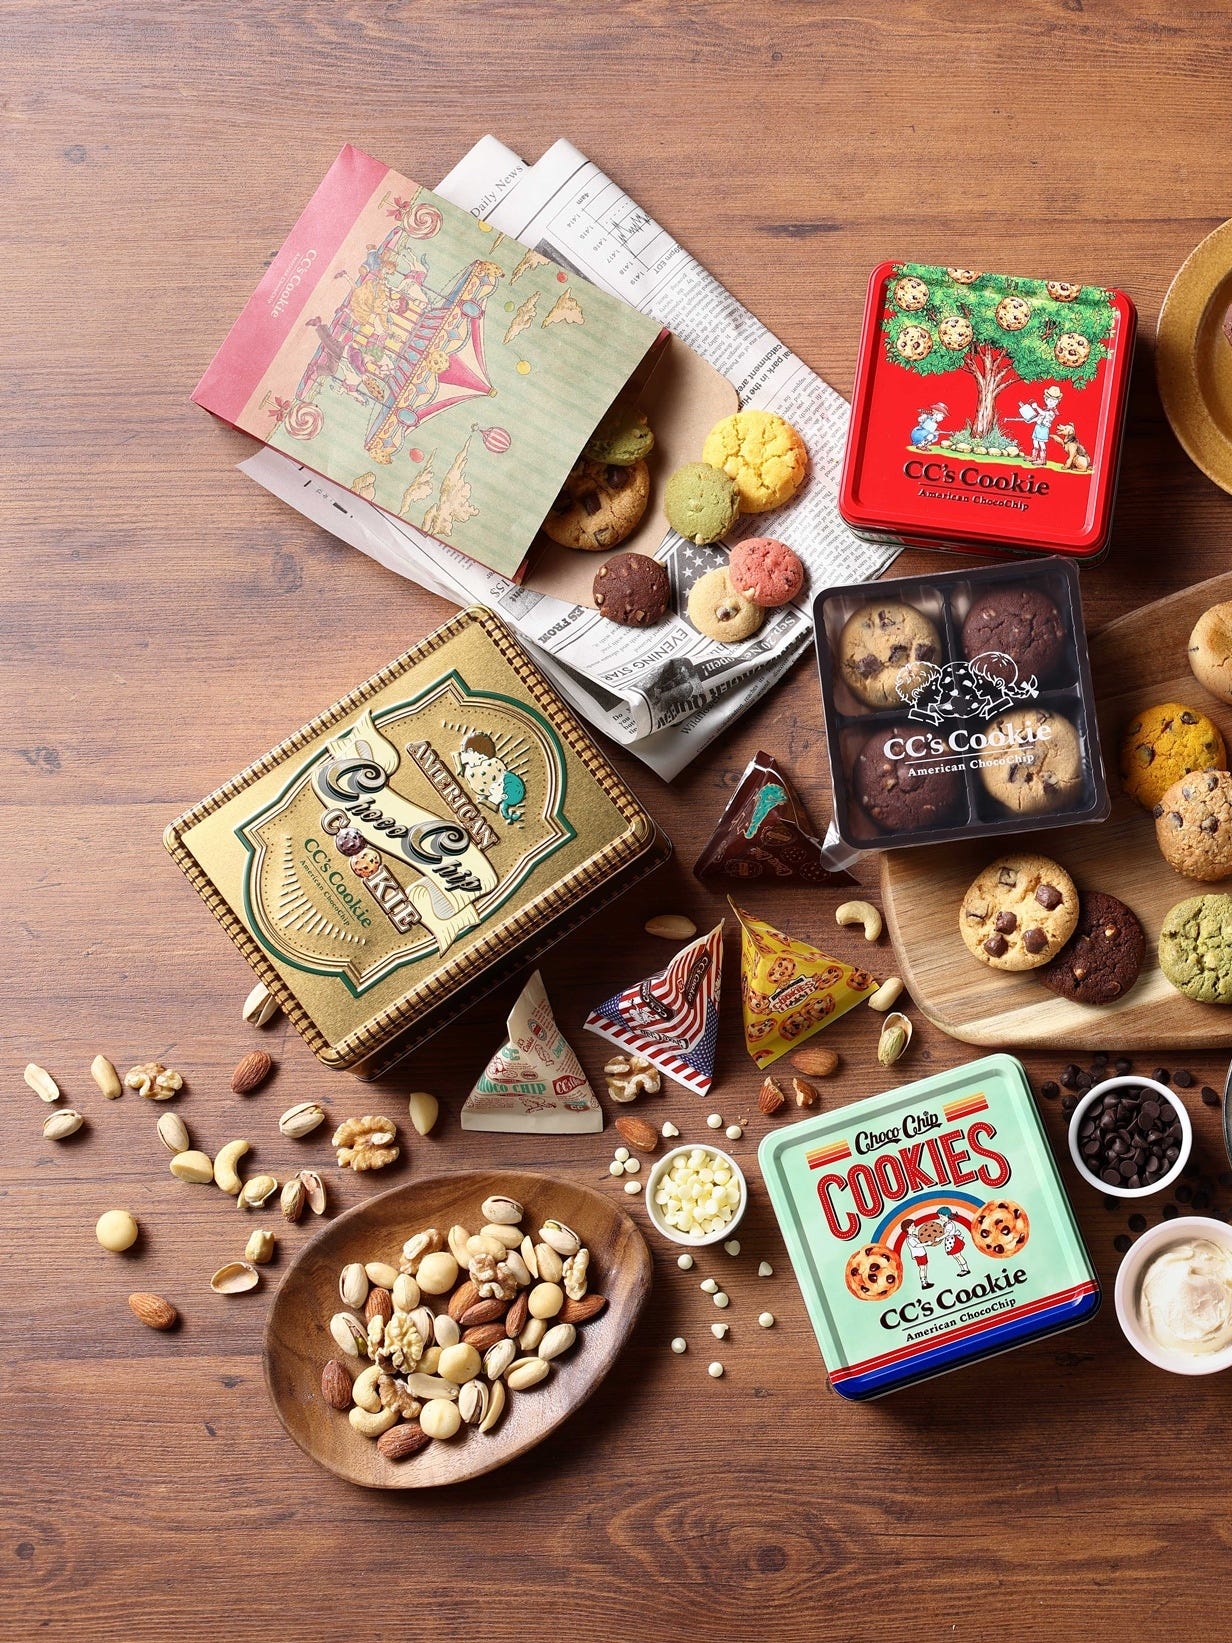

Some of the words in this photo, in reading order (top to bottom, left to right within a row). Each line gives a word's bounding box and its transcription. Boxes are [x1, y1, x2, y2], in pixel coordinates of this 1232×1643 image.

[470, 190, 497, 218] Daily
[495, 163, 523, 191] News
[653, 260, 667, 274] EDT
[271, 276, 300, 317] Cookie
[747, 343, 783, 381] catchment
[759, 373, 770, 384] in
[766, 356, 784, 376] park
[748, 382, 763, 397] the
[903, 460, 955, 485] CC's
[961, 467, 1050, 496] Cookie
[918, 488, 969, 504] American
[972, 494, 1030, 512] ChocoChip
[537, 617, 571, 646] FROM
[632, 627, 688, 672] EVENING
[600, 665, 633, 683] STAR
[883, 733, 944, 760] CC's
[948, 720, 1053, 753] Cookie
[907, 762, 966, 777] American
[969, 753, 1035, 770] ChocoChip
[405, 740, 501, 852] AMERICAN
[318, 757, 408, 840] Choco
[401, 819, 483, 893] Chip
[299, 859, 324, 891] American
[322, 890, 350, 927] ChocoChip
[304, 835, 333, 874] CC's
[326, 869, 372, 930] Cookie
[855, 1128, 902, 1156] Choco
[902, 1111, 943, 1137] Chip
[816, 1120, 1011, 1241] COOKIES
[879, 1298, 934, 1330] CC's
[936, 1267, 1028, 1309] Cookie
[906, 1317, 958, 1342] American
[960, 1296, 1017, 1323] ChocoChip
